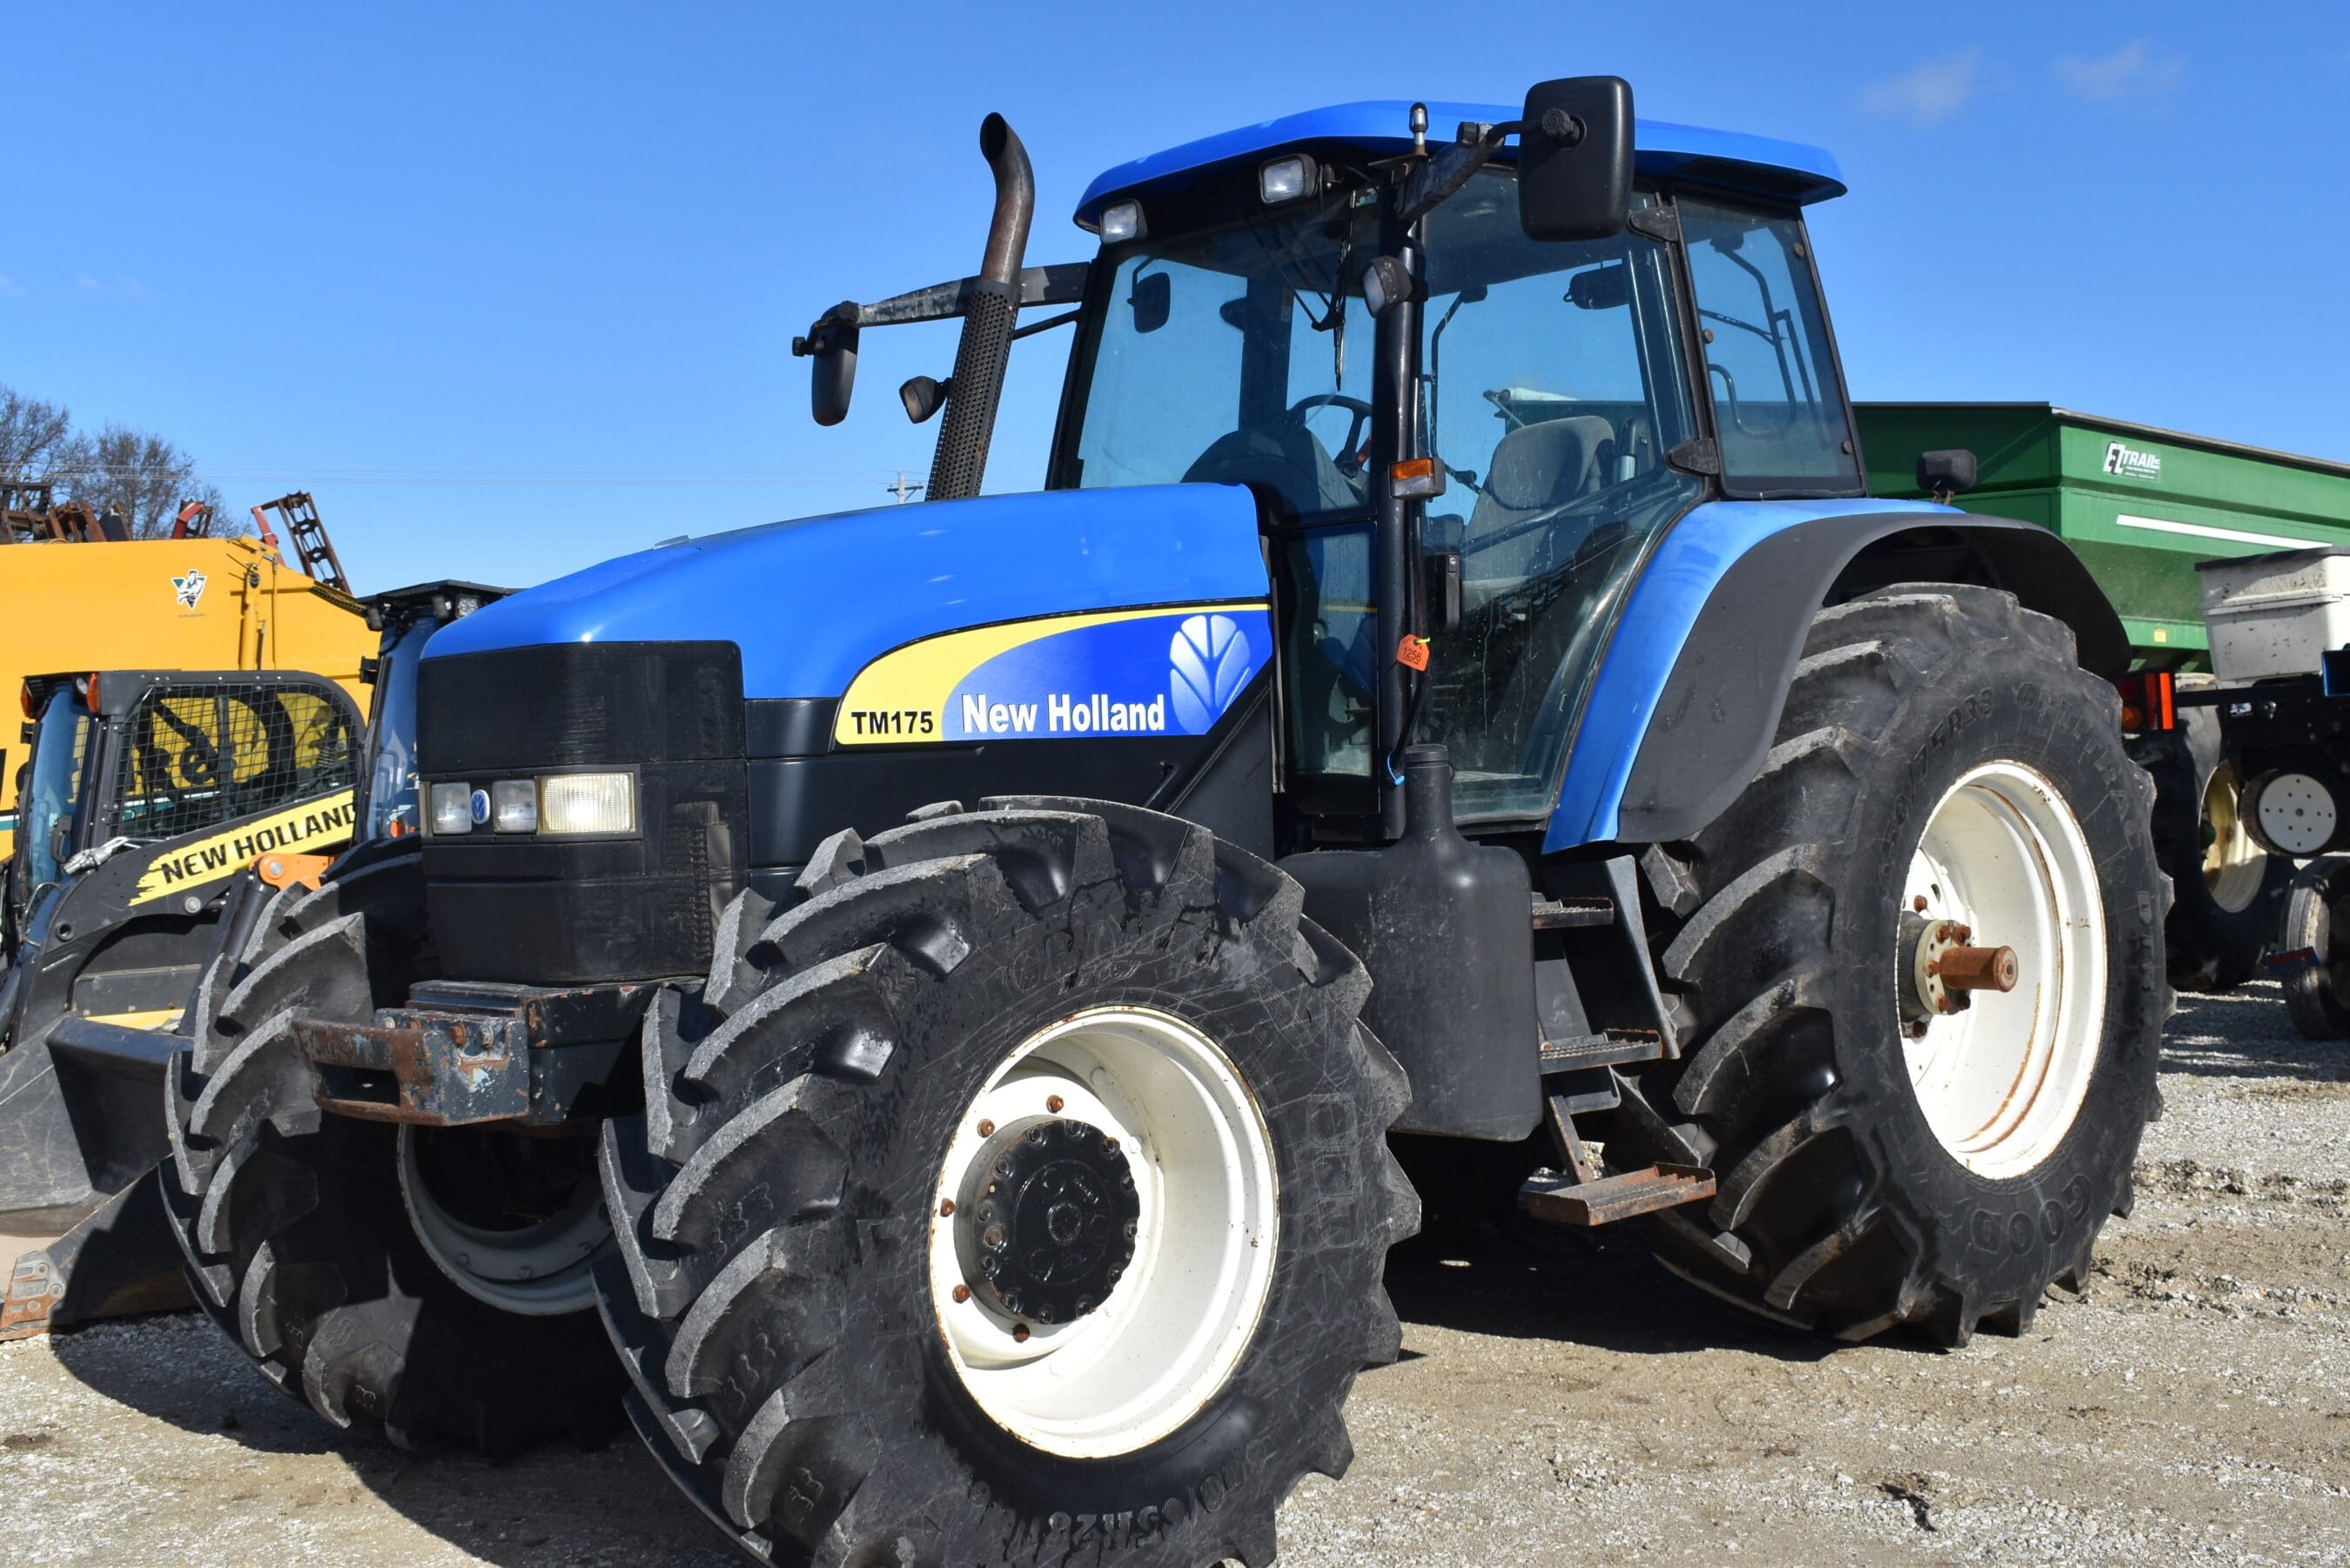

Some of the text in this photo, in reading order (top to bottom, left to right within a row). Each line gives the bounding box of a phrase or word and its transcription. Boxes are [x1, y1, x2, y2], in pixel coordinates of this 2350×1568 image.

[2123, 450, 2160, 468] TRAIL
[851, 710, 934, 734] TM175
[961, 693, 1165, 733] New Holland
[160, 801, 357, 884] NEW HOLLAND
